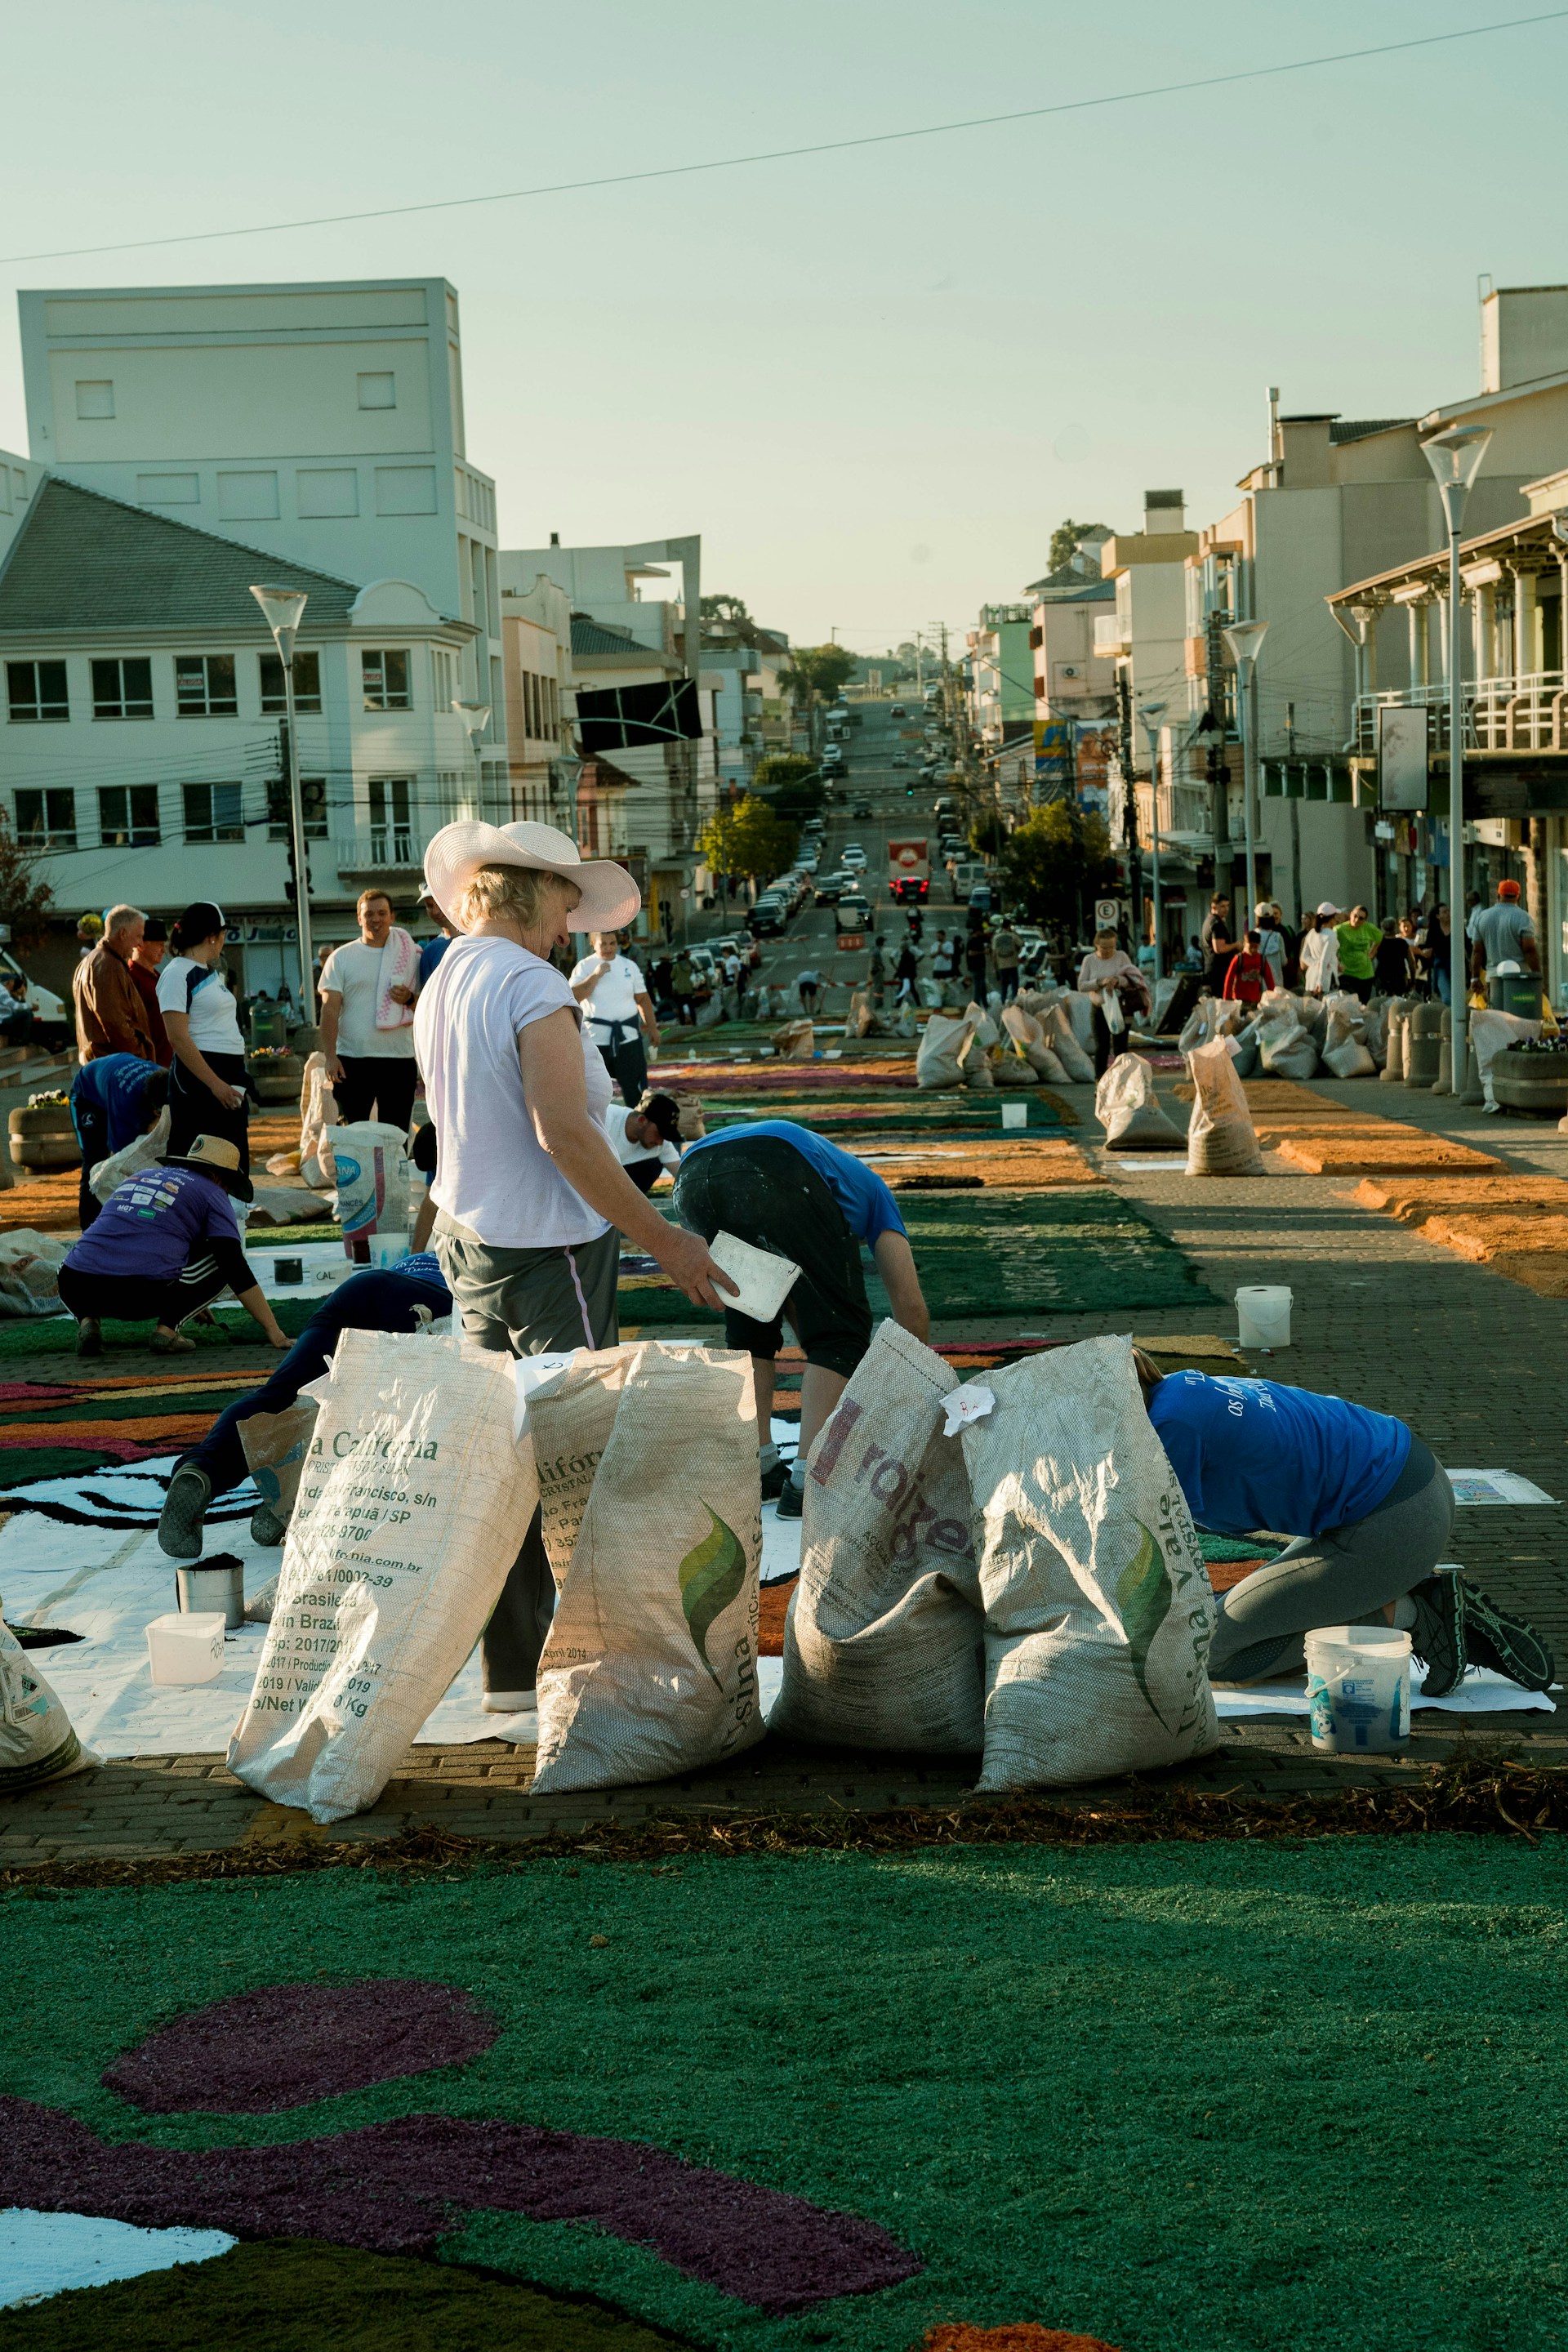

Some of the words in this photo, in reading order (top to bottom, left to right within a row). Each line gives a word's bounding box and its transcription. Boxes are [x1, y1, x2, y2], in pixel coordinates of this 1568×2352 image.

[1102, 906, 1110, 915] E
[315, 1270, 336, 1281] CAL
[540, 1474, 591, 1499] CRYSTAL
[413, 1492, 438, 1508] s/n
[389, 1510, 412, 1525] SP
[1159, 1494, 1193, 1593] Vale
[1175, 1606, 1210, 1739] Usina
[345, 1696, 369, 1718] Kg
